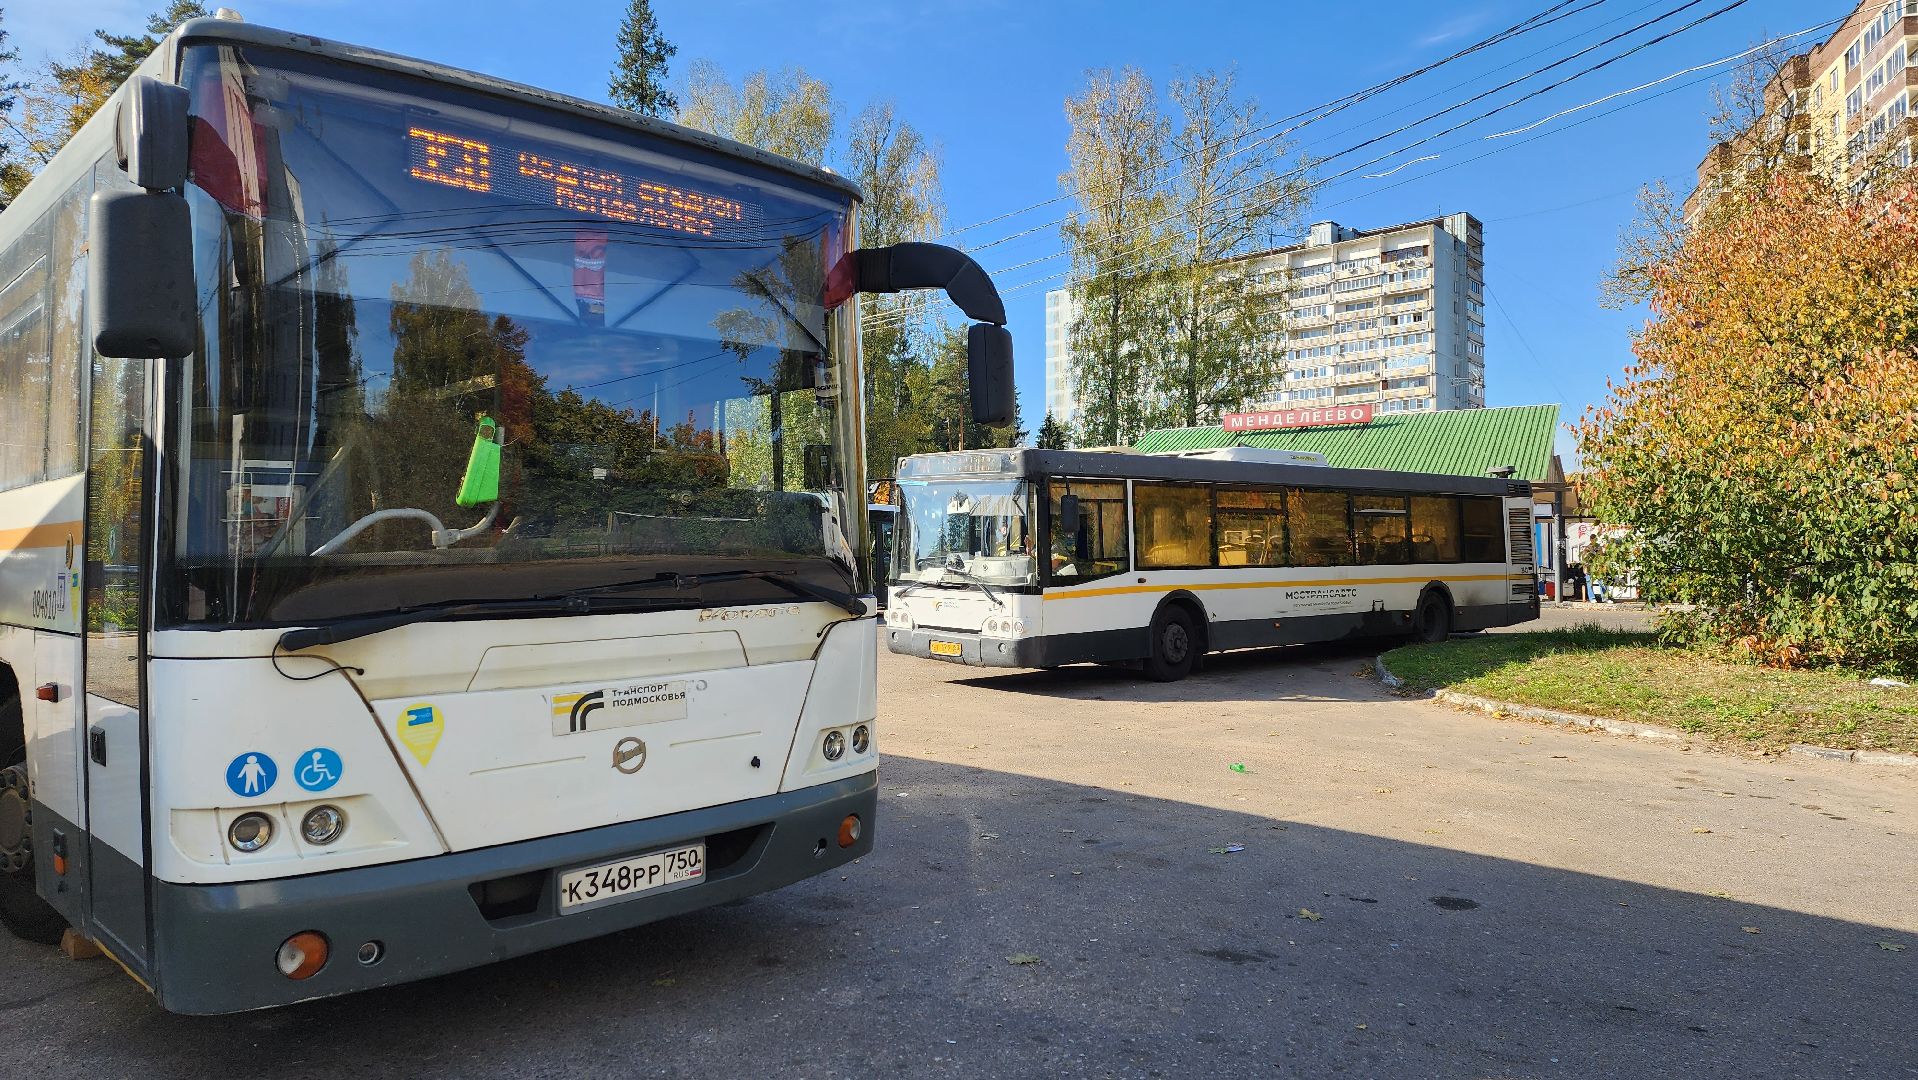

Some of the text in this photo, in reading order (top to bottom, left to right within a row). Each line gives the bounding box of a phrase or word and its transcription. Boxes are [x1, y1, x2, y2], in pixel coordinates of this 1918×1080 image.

[1231, 408, 1364, 428] МЕНДЕЛЕЕВО
[612, 683, 669, 697] ТРАНСПОРТ
[612, 691, 687, 708] ПОДМОСКОВЬЯ
[568, 849, 698, 903] К348РР 750
[673, 870, 690, 880] RUS
